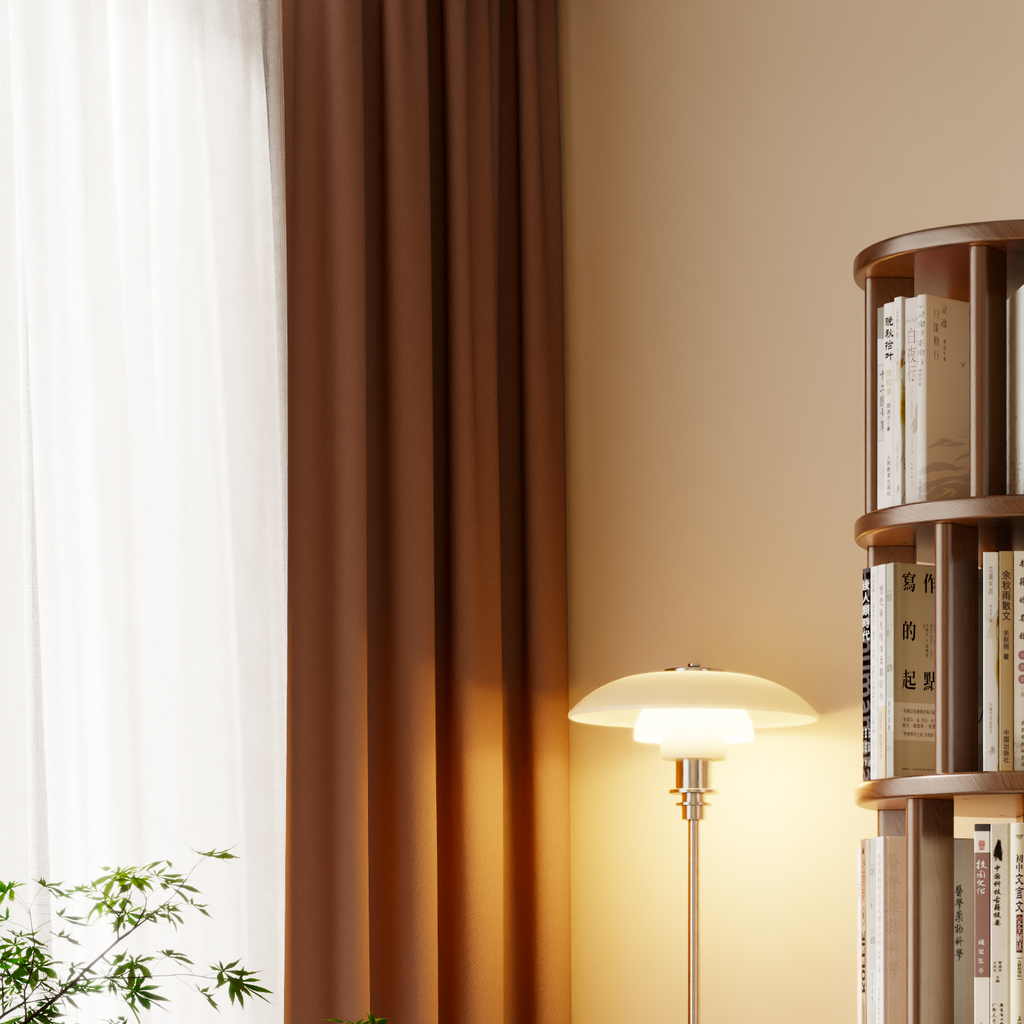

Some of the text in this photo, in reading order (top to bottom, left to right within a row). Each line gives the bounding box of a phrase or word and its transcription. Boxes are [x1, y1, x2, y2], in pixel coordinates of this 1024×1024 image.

[907, 327, 917, 382] 白夜行
[1001, 570, 1012, 621] 余秋雨散文
[902, 620, 917, 642] 的
[1015, 853, 1024, 913] 初中文言文
